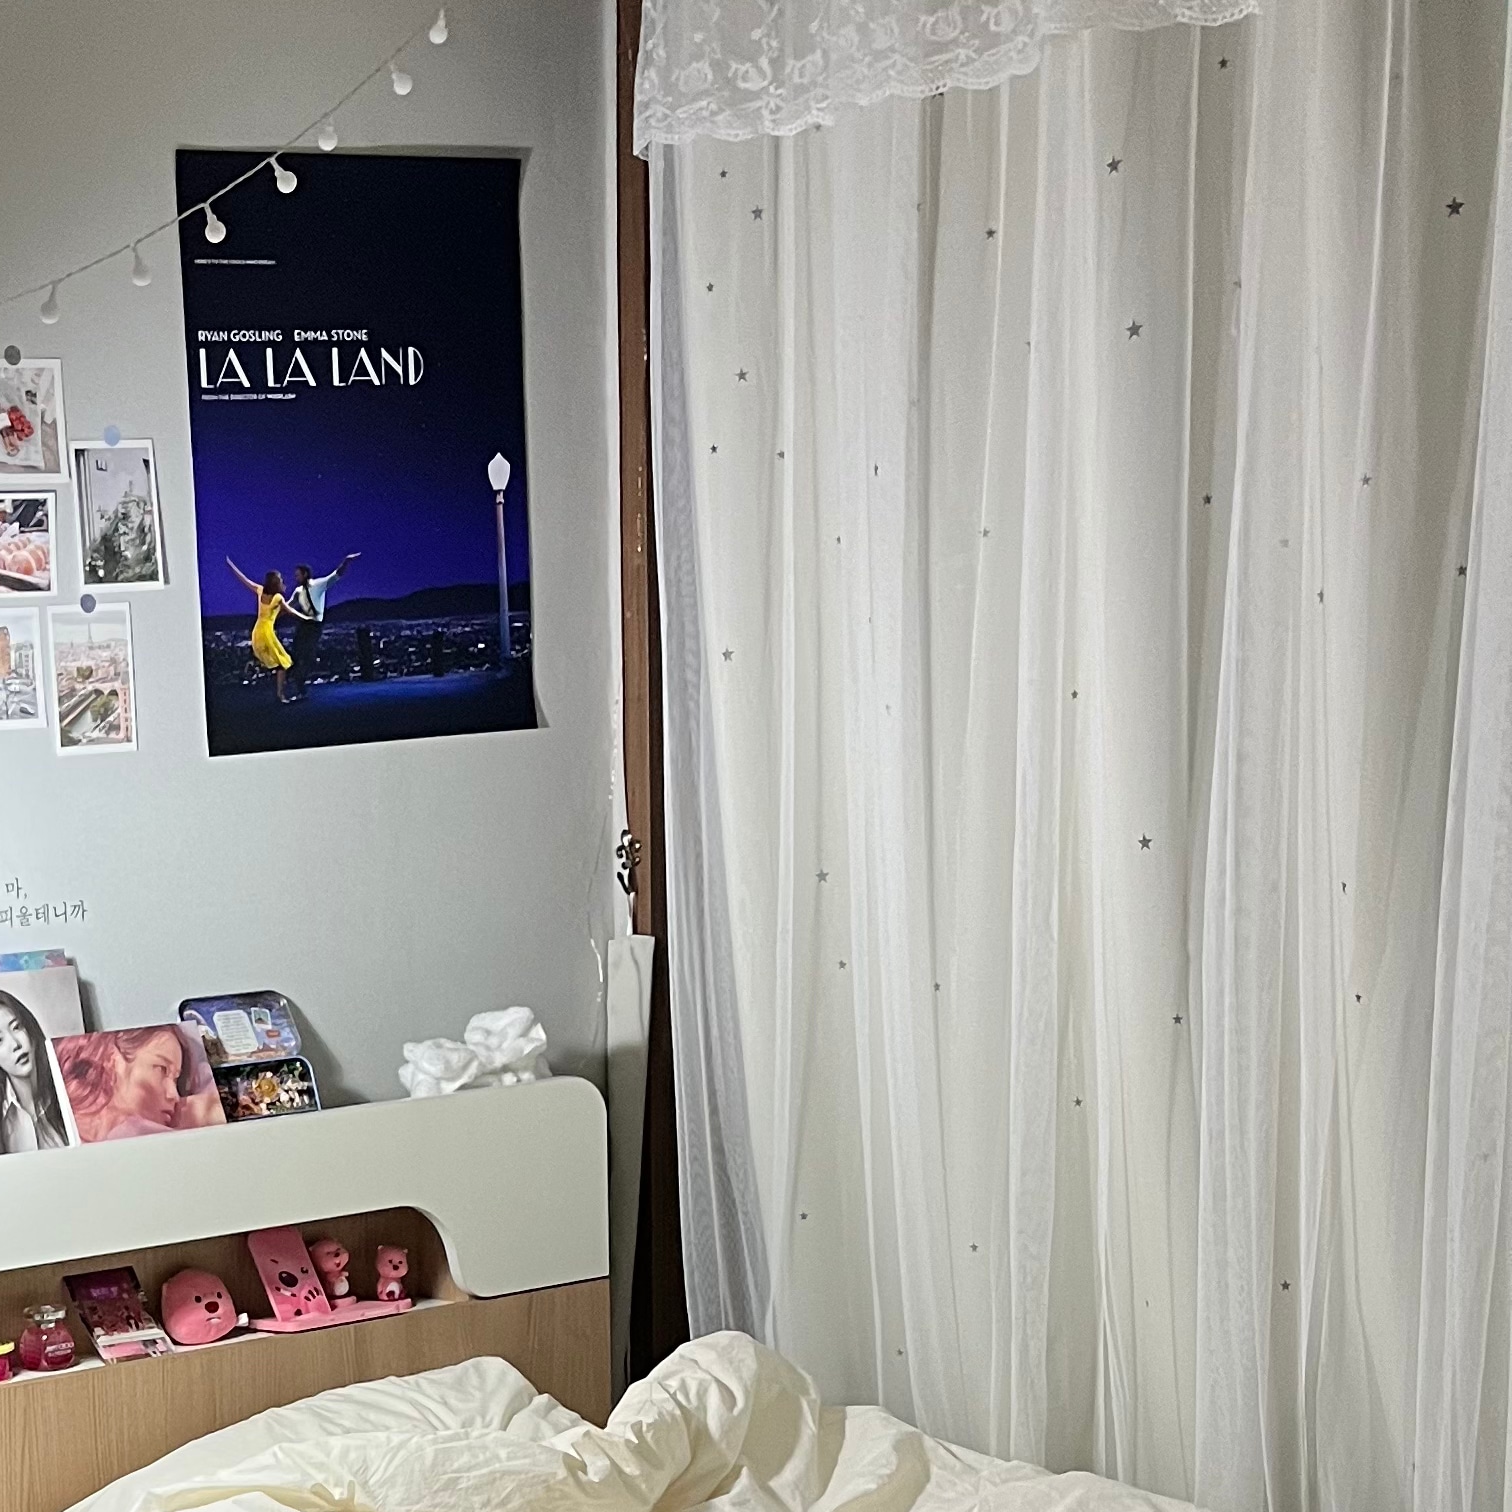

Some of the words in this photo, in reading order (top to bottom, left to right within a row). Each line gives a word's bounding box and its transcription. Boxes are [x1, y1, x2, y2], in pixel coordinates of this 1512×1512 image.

[197, 330, 228, 342] RYAN
[230, 329, 283, 342] GOSLING
[293, 329, 329, 341] EMMA
[330, 329, 369, 341] STONE
[199, 347, 251, 389] LA
[265, 347, 317, 388] LA
[331, 346, 425, 386] LAND
